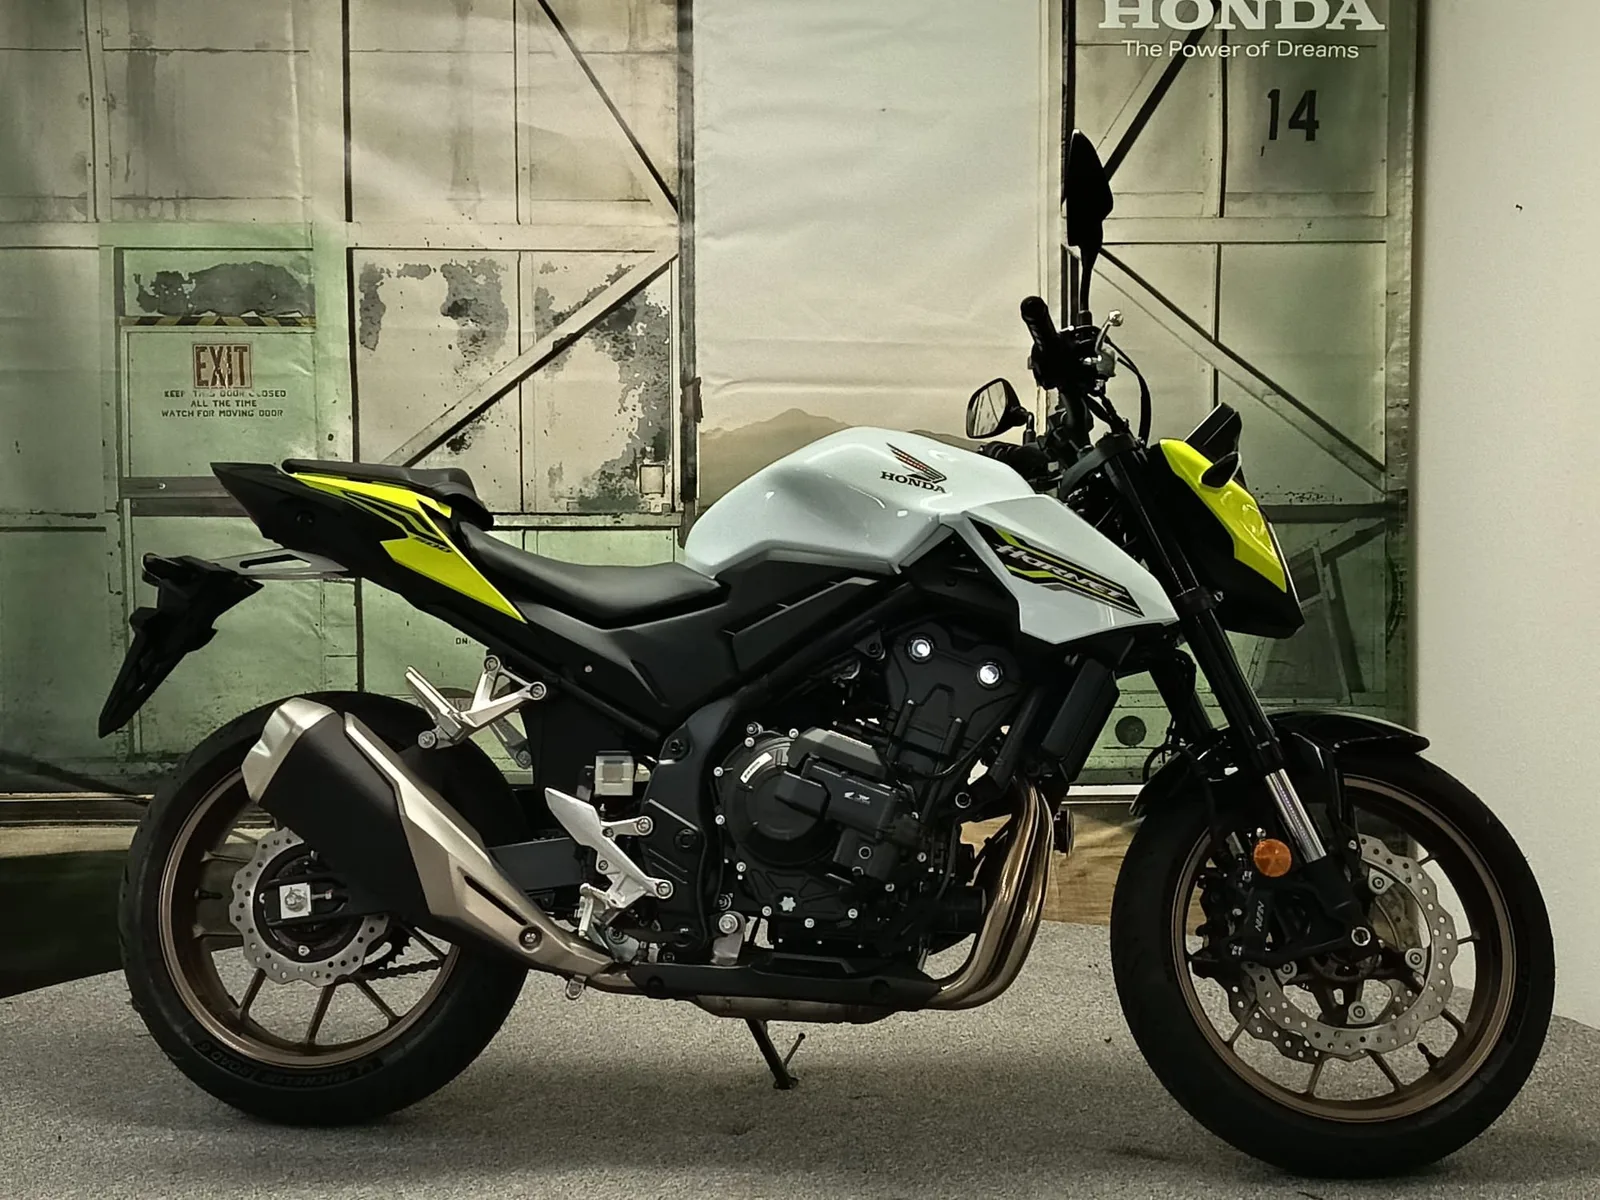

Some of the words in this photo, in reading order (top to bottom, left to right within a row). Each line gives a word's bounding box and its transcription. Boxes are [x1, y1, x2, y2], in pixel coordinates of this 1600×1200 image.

[1099, 0, 1386, 31] HONDA
[1121, 40, 1163, 58] The
[1168, 40, 1241, 59] Power
[1245, 40, 1270, 58] of
[1277, 40, 1360, 60] Dreams
[1267, 88, 1320, 142] 14
[195, 346, 248, 386] EXIT
[161, 409, 194, 418] WATCH
[197, 409, 215, 418] FOR
[218, 409, 255, 418] MOVING
[258, 409, 284, 418] DOOR
[190, 399, 209, 408] ALL
[212, 399, 231, 408] THE
[235, 399, 257, 408] TIME
[879, 471, 947, 494] HONDA
